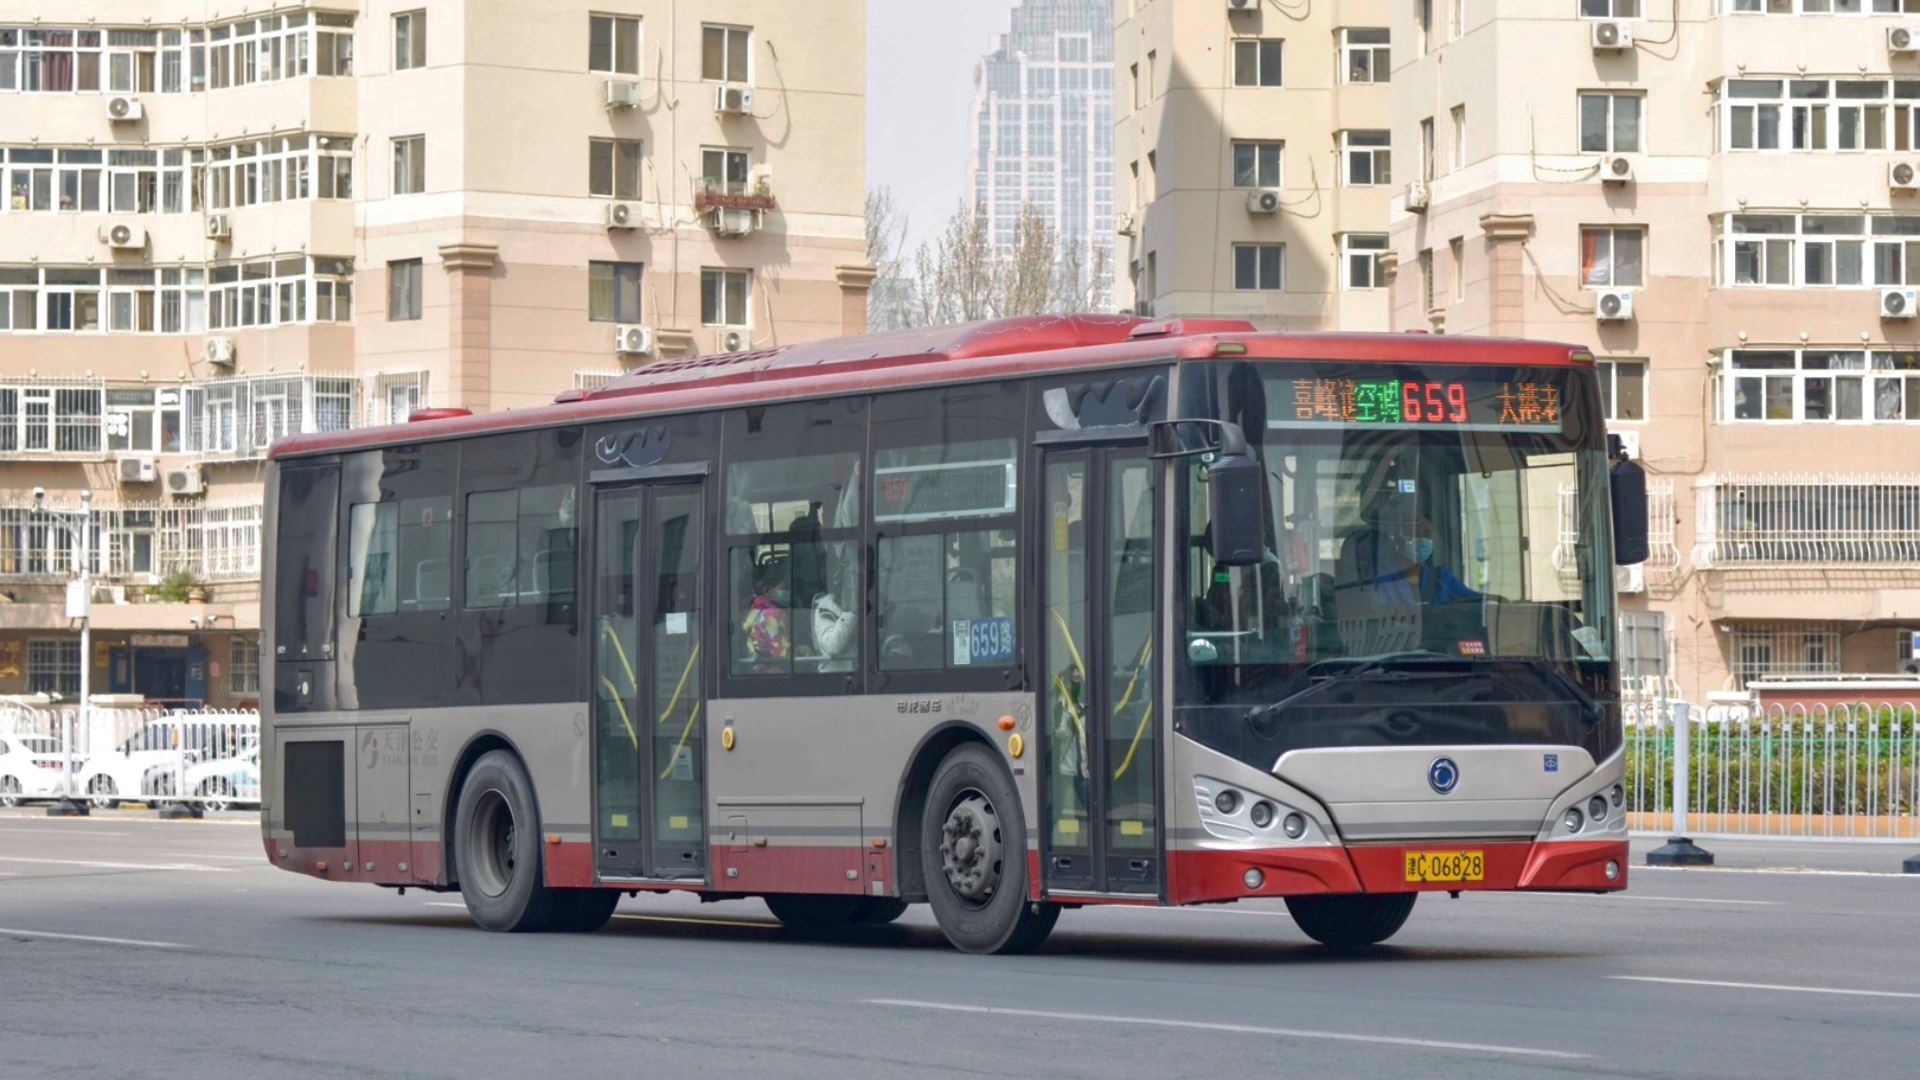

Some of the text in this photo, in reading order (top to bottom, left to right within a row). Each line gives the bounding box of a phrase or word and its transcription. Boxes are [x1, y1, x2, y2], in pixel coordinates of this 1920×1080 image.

[1354, 380, 1399, 422] 空调
[1403, 382, 1466, 421] 659
[972, 620, 1012, 657] 659路
[383, 729, 439, 752] 天津公交
[382, 754, 439, 767] TIANJN BUS
